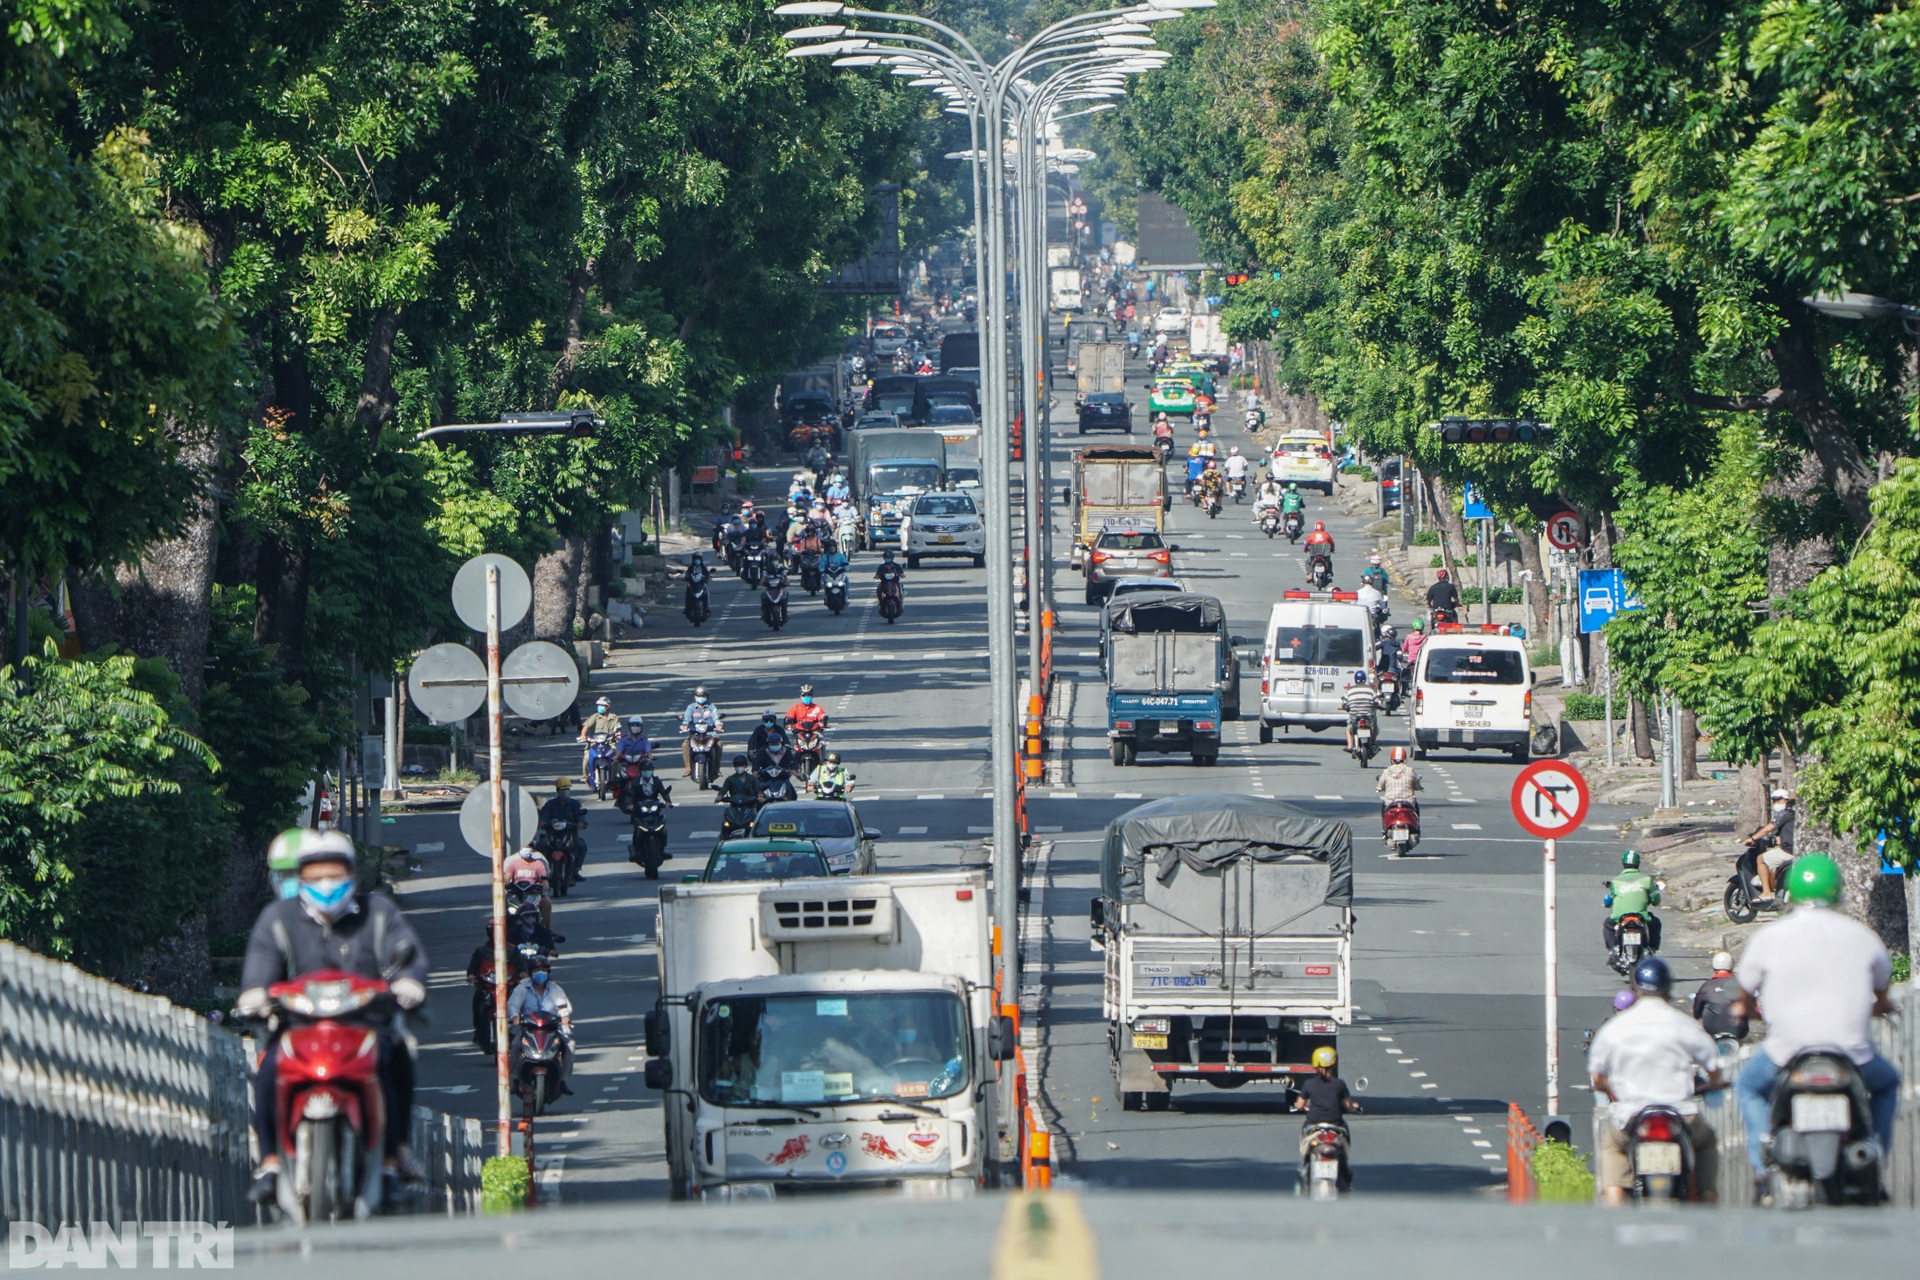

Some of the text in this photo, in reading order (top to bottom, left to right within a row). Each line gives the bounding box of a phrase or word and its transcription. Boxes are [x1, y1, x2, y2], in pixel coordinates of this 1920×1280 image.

[1304, 666, 1340, 677] 62B-011.09
[1141, 698, 1178, 706] 64C-047.71
[1150, 976, 1207, 987] 71C-092.46
